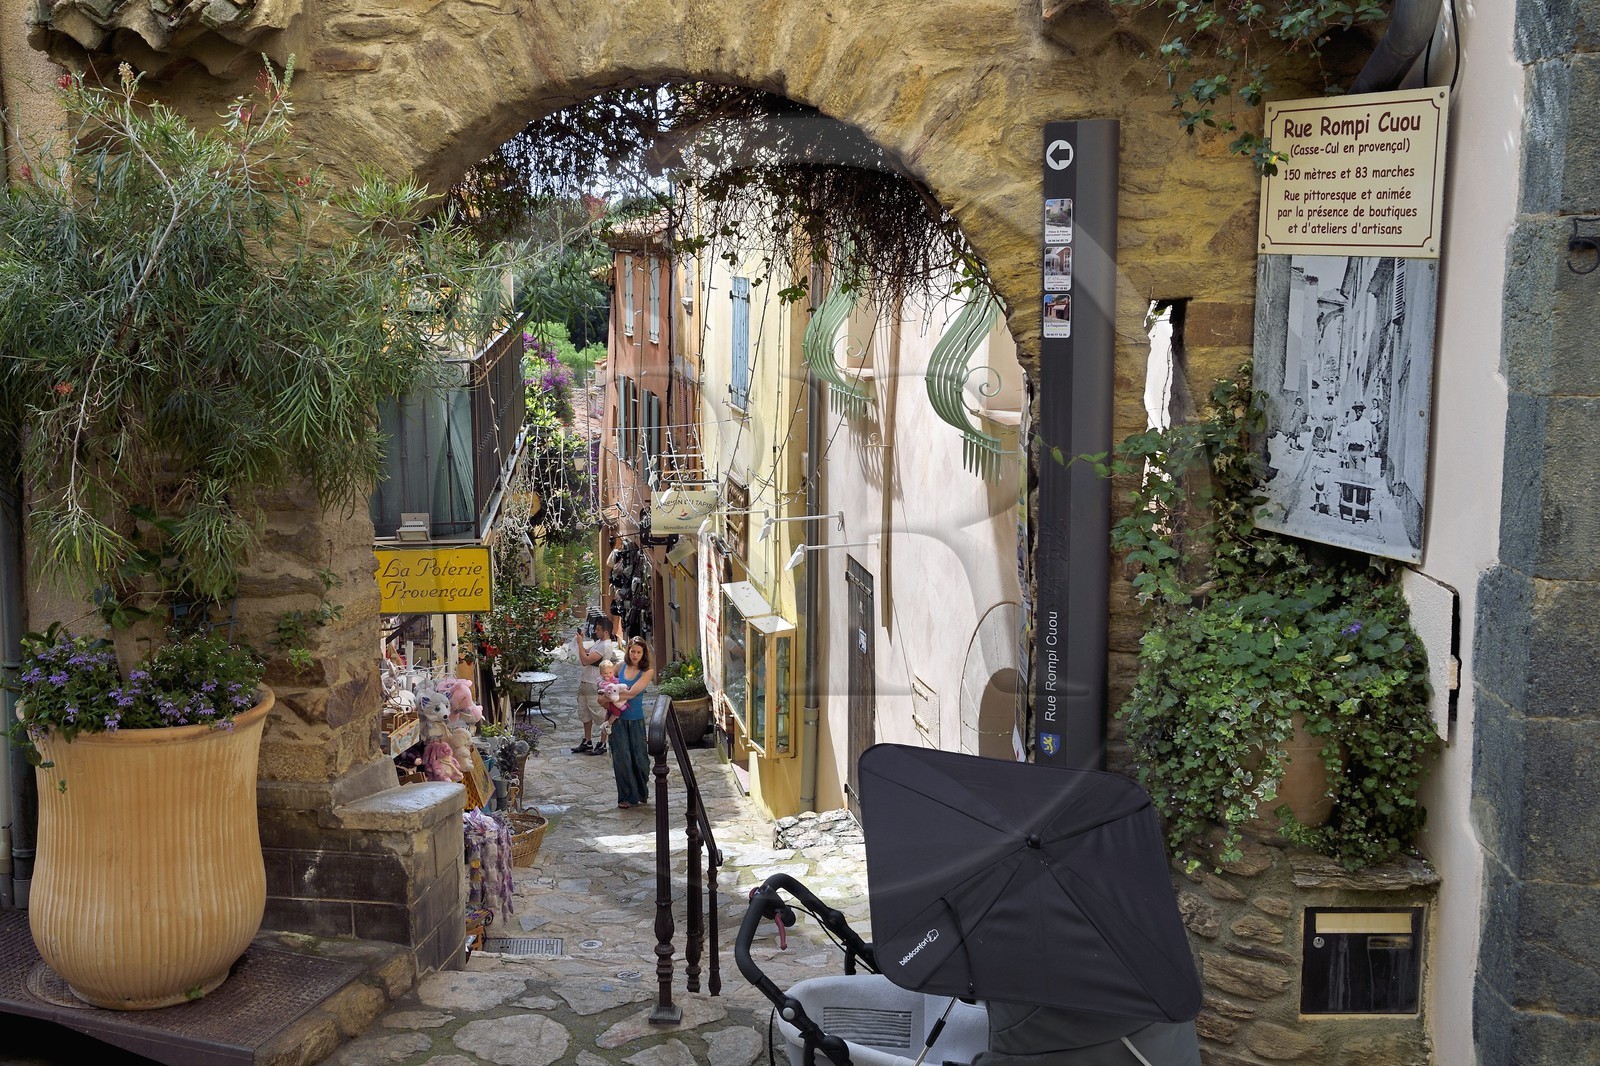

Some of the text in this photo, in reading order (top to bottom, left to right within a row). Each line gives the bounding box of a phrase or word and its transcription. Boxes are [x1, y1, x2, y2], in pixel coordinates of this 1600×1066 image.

[1284, 111, 1421, 141] Rue Rompi Cuou
[1290, 138, 1410, 158] (Casse-Cul en provençal)
[1284, 165, 1415, 181] 150 mètres et 83 marches
[1284, 186, 1412, 204] Rue pittoresque et animée
[1277, 205, 1418, 220] par la présence de boutiques
[1288, 222, 1403, 235] et d'ateliers d'artisans
[696, 499, 713, 508] TAPIS
[382, 558, 483, 577] La Poterie
[384, 578, 484, 602] Provençale
[1044, 611, 1060, 722] Rue Rompi Cuou
